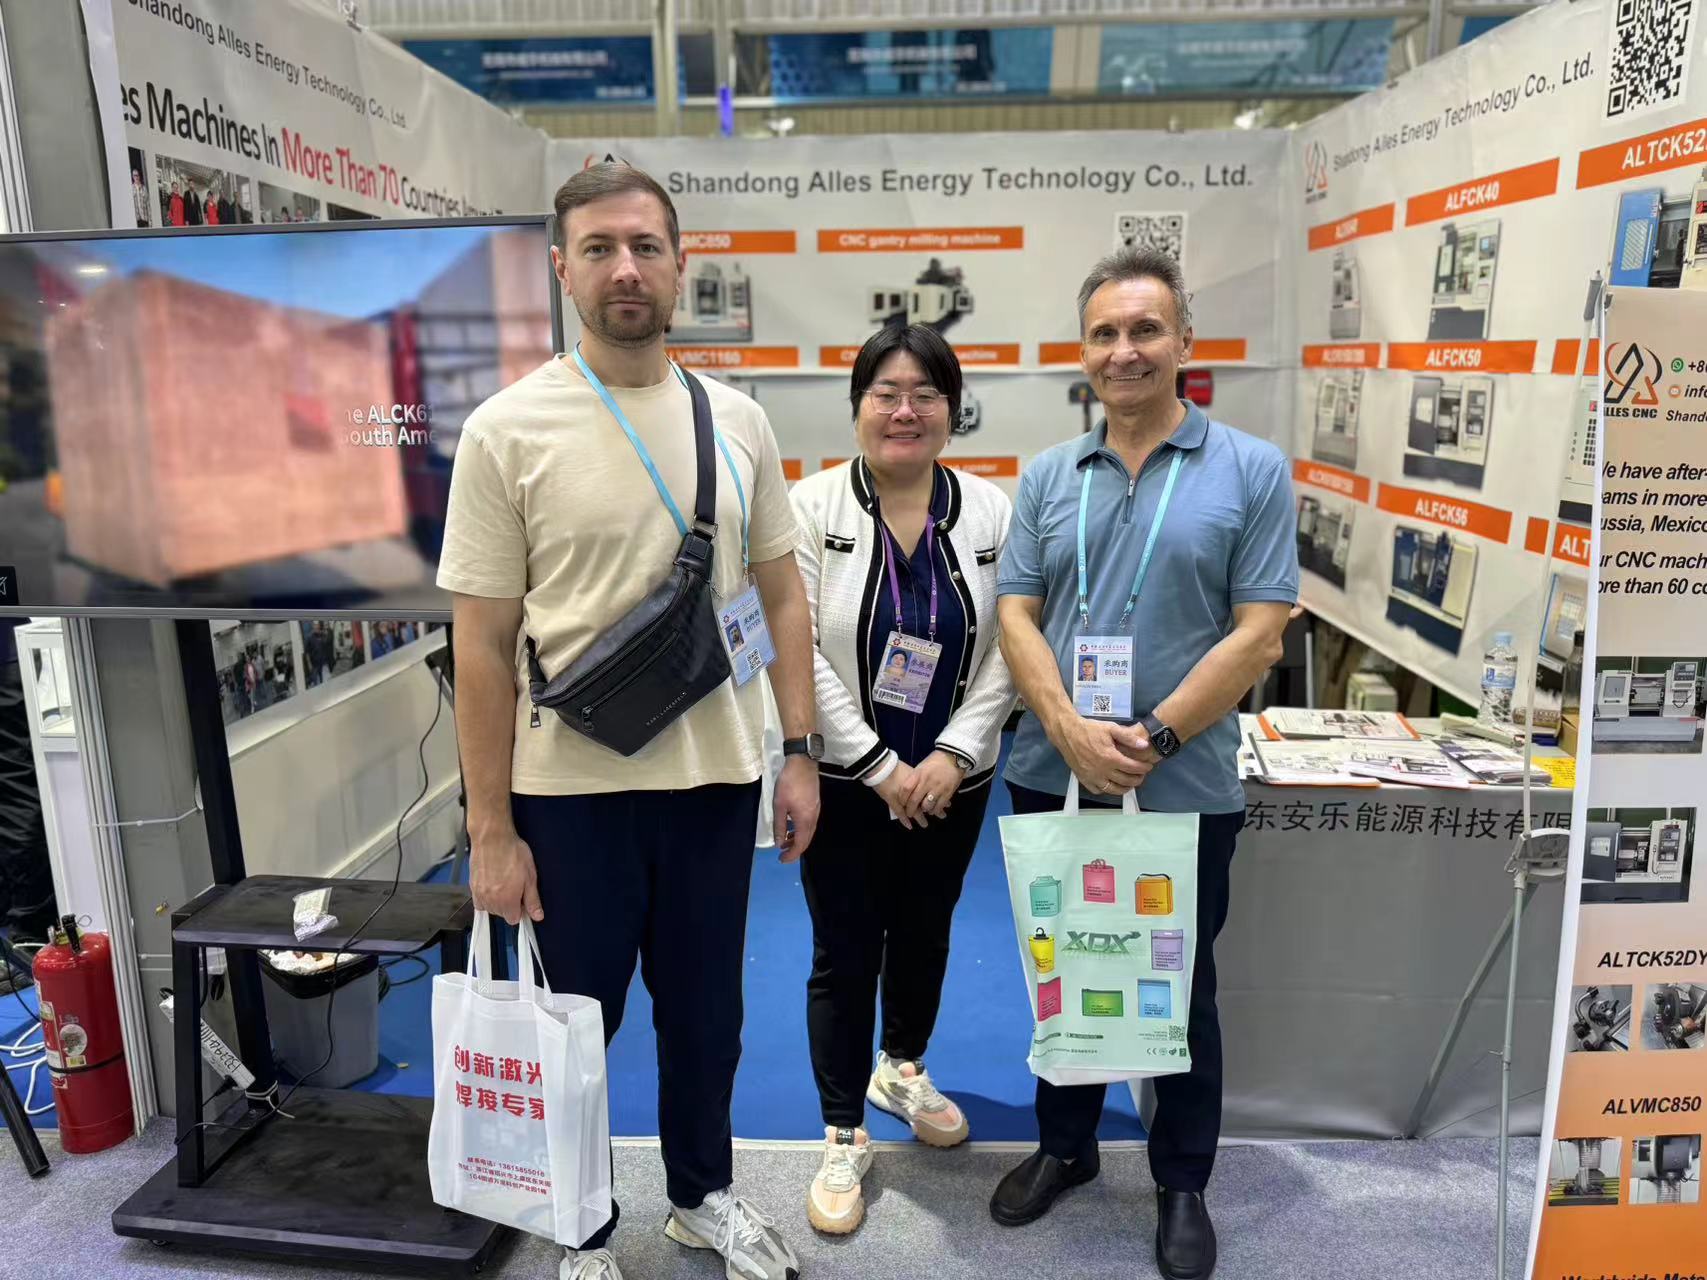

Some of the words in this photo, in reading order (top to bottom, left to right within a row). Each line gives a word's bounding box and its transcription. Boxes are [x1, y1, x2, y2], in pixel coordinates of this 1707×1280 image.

[128, 0, 215, 44] handong
[218, 24, 251, 58] Alles
[255, 43, 300, 84] Energy
[302, 65, 366, 116] Technology
[1401, 115, 1441, 145] Energy
[1444, 83, 1520, 129] Technology
[1525, 73, 1556, 97] Co.,
[1562, 52, 1595, 85] Ltd.
[146, 82, 261, 160] Machines
[261, 123, 281, 168] In
[281, 127, 334, 186] More
[334, 147, 378, 199] Than
[379, 163, 400, 206] 70
[1621, 128, 1707, 170] ALTCK52
[667, 172, 799, 198] Shandong
[807, 171, 872, 193] Alles
[880, 169, 973, 196] Energy
[982, 166, 1136, 193] Technology
[1144, 164, 1195, 189] Co.,
[1204, 164, 1253, 187] Ltd.
[1445, 182, 1499, 212] ALFCK40
[839, 234, 866, 246] CNC
[1426, 348, 1482, 367] ALFCK50
[1688, 360, 1707, 373] +8
[367, 404, 433, 424] ALCK6
[1604, 407, 1629, 417] LLES
[1632, 408, 1658, 418] CNC
[1666, 410, 1707, 422] Shand
[1620, 461, 1662, 479] have
[1641, 489, 1658, 505] in
[1662, 493, 1707, 506] more
[1415, 498, 1468, 526] ALFCK56
[1616, 551, 1656, 568] CNC
[1624, 577, 1663, 594] than
[1668, 578, 1688, 594] 60
[1597, 950, 1707, 967] ALTCK52DY
[1602, 1096, 1702, 1114] ALVMC850
